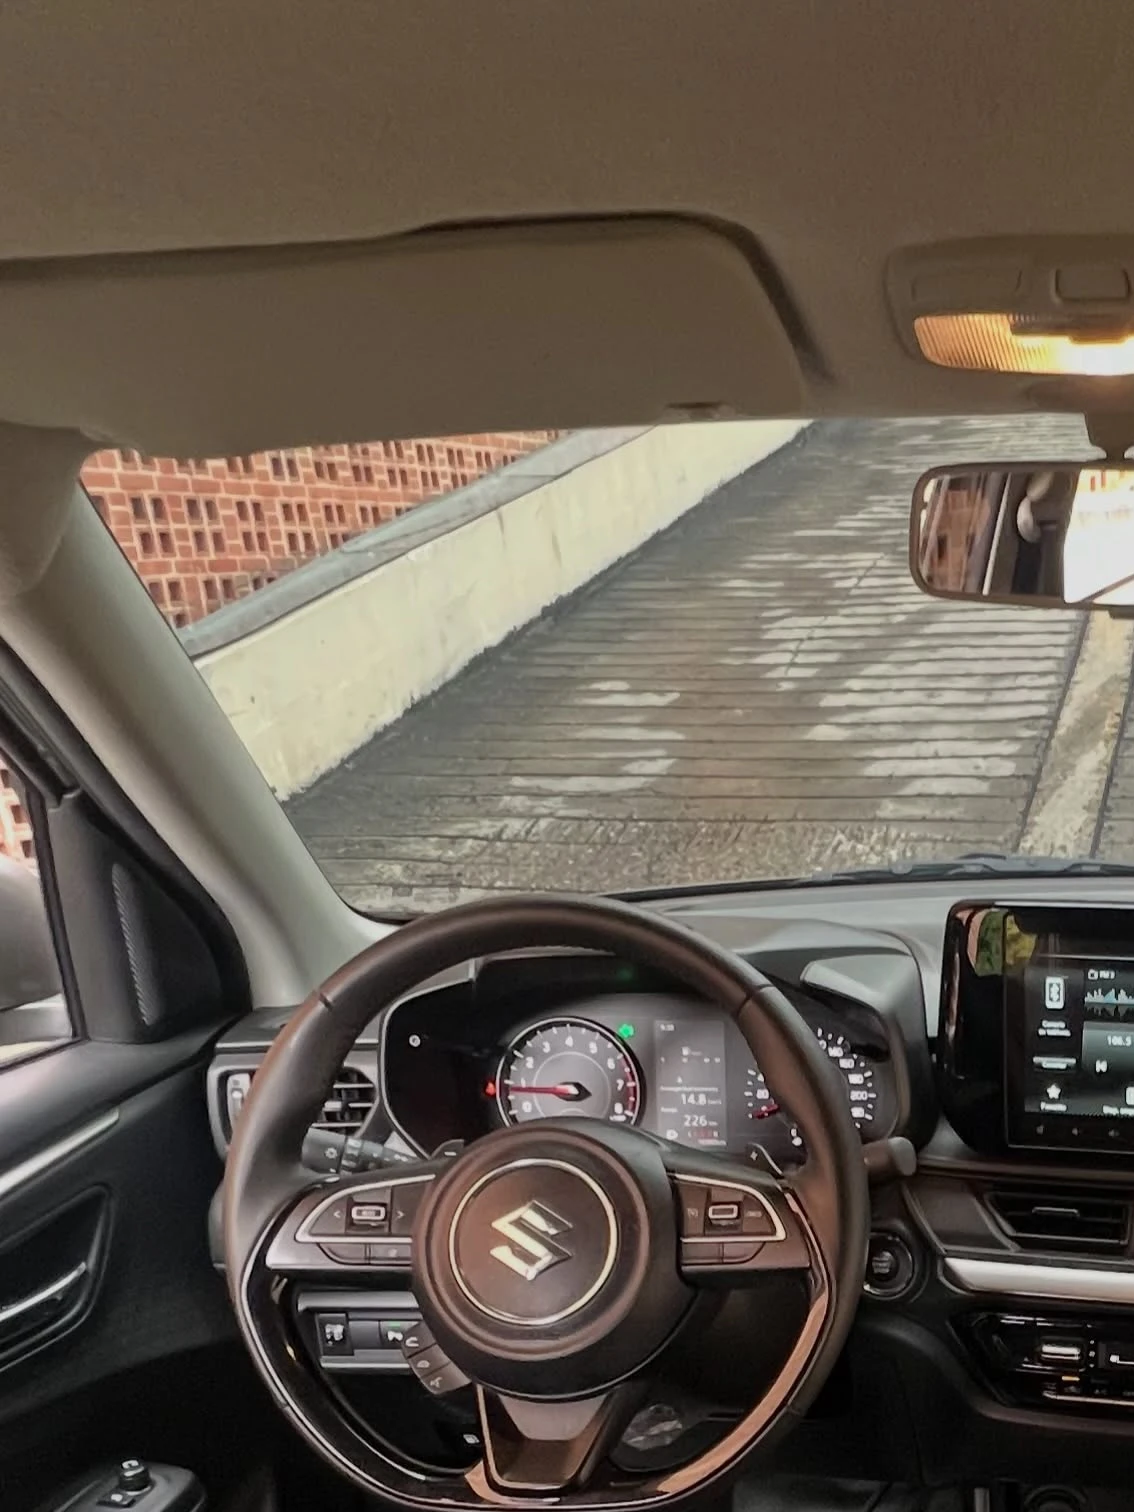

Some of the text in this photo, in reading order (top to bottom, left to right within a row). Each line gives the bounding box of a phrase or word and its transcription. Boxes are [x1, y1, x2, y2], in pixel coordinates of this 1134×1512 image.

[565, 1035, 574, 1047] 4
[525, 1056, 534, 1069] 2
[607, 1057, 616, 1070] 6
[616, 1079, 624, 1091] 7
[684, 1114, 708, 1127] 226
